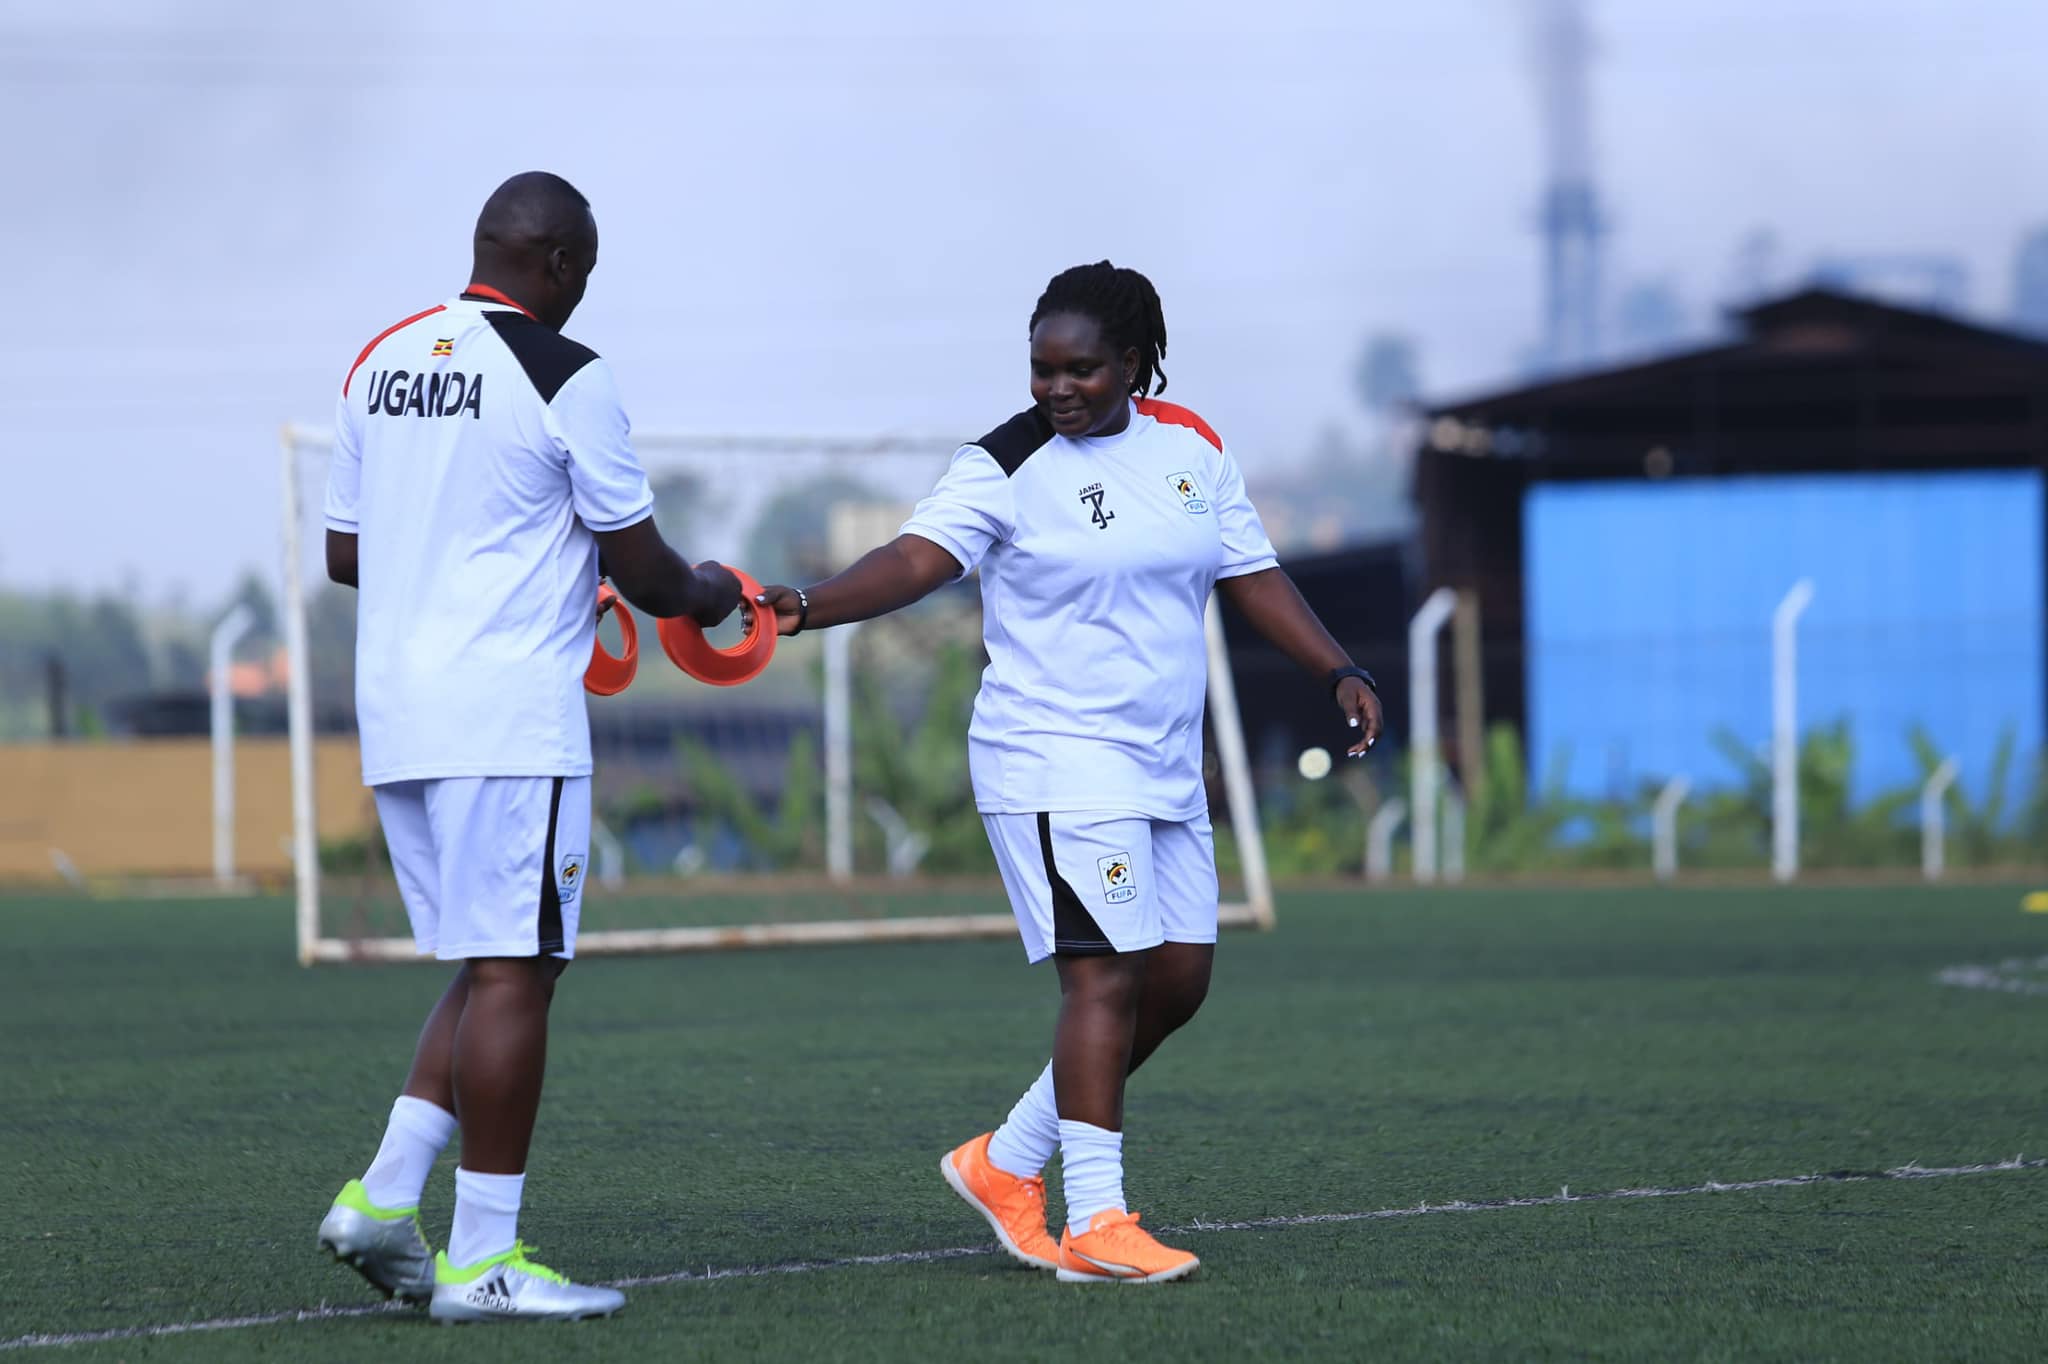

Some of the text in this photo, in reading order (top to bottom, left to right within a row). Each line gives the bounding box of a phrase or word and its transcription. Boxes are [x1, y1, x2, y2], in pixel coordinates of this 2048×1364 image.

[368, 370, 483, 419] UGANDA
[1078, 482, 1103, 496] JANZI
[466, 1292, 518, 1312] adidas
